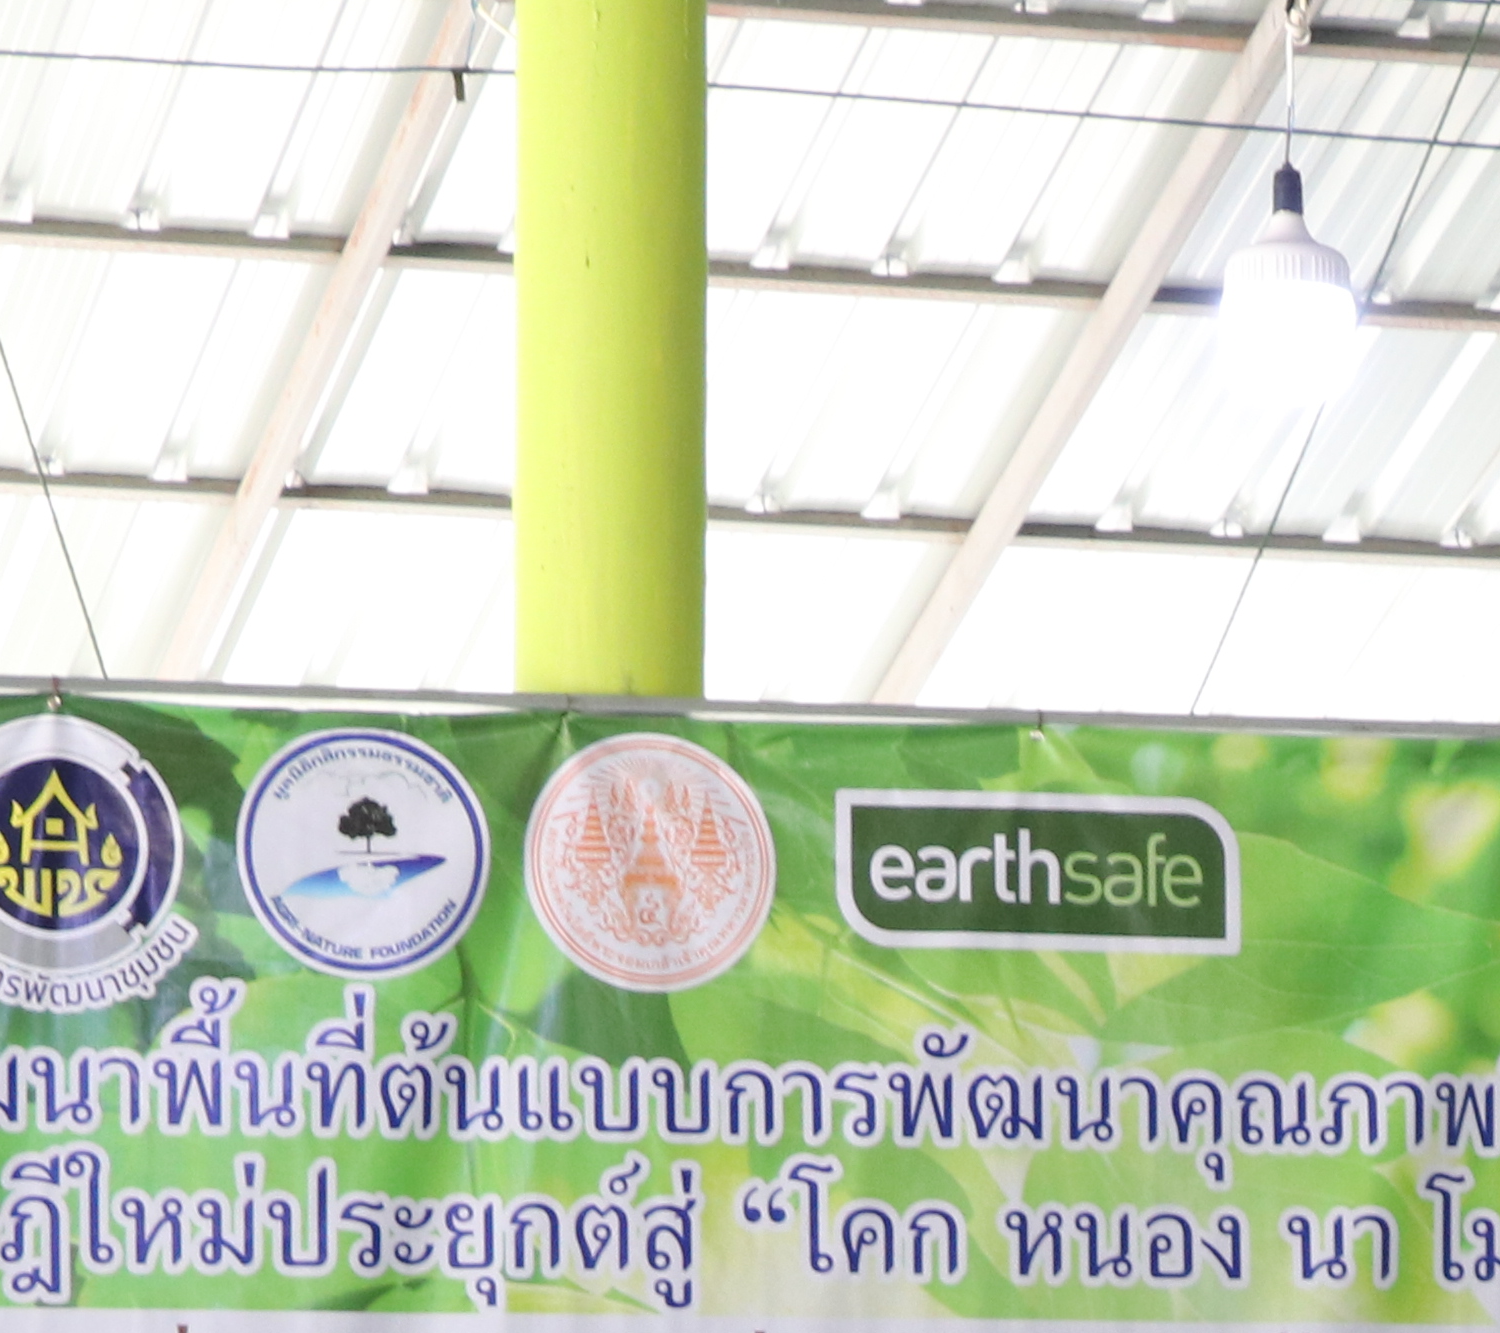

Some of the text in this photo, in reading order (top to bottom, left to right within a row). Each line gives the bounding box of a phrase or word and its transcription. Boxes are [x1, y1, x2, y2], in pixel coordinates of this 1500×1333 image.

[869, 828, 1203, 908] earthsafe
[370, 899, 457, 959] FOUNDATION
[1007, 1210, 1242, 1279] หนอง
[1288, 1214, 1391, 1280] นา
